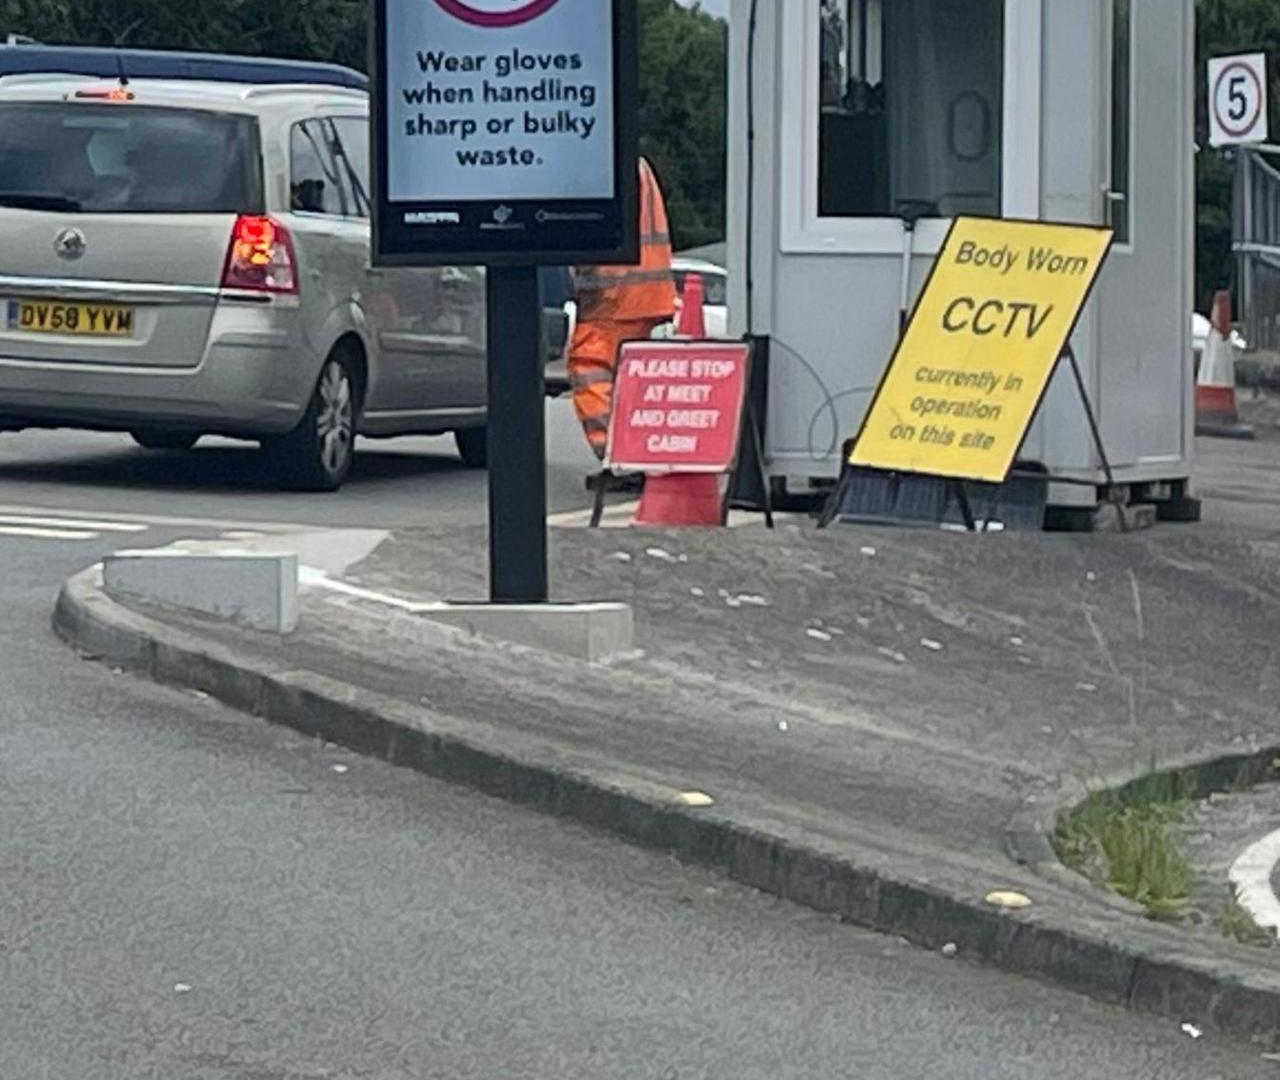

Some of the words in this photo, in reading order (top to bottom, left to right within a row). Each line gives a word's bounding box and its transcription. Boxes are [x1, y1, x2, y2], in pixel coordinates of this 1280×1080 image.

[416, 50, 487, 72] Wear
[495, 47, 583, 77] gloves
[402, 81, 475, 104] when
[482, 77, 597, 107] handling
[1228, 76, 1247, 120] 5
[404, 112, 477, 140] sharp
[486, 117, 514, 135] or
[523, 110, 596, 139] bulky
[456, 146, 543, 166] waste.
[954, 240, 1019, 275] Body
[1026, 246, 1089, 275] Worn
[21, 305, 79, 329] DV58
[86, 307, 132, 331] YVM
[942, 296, 1054, 339] CCTV
[628, 359, 689, 378] PLEASE
[690, 359, 736, 378] STOP
[914, 365, 1001, 393] currently
[1004, 372, 1023, 392] in
[643, 384, 666, 402] AT
[667, 384, 713, 403] MEET
[629, 409, 666, 427] AND
[666, 409, 721, 428] GREET
[910, 394, 1001, 421] operation
[646, 435, 697, 453] CABIN
[890, 424, 915, 441] on
[920, 424, 956, 447] this
[959, 428, 996, 450] site
